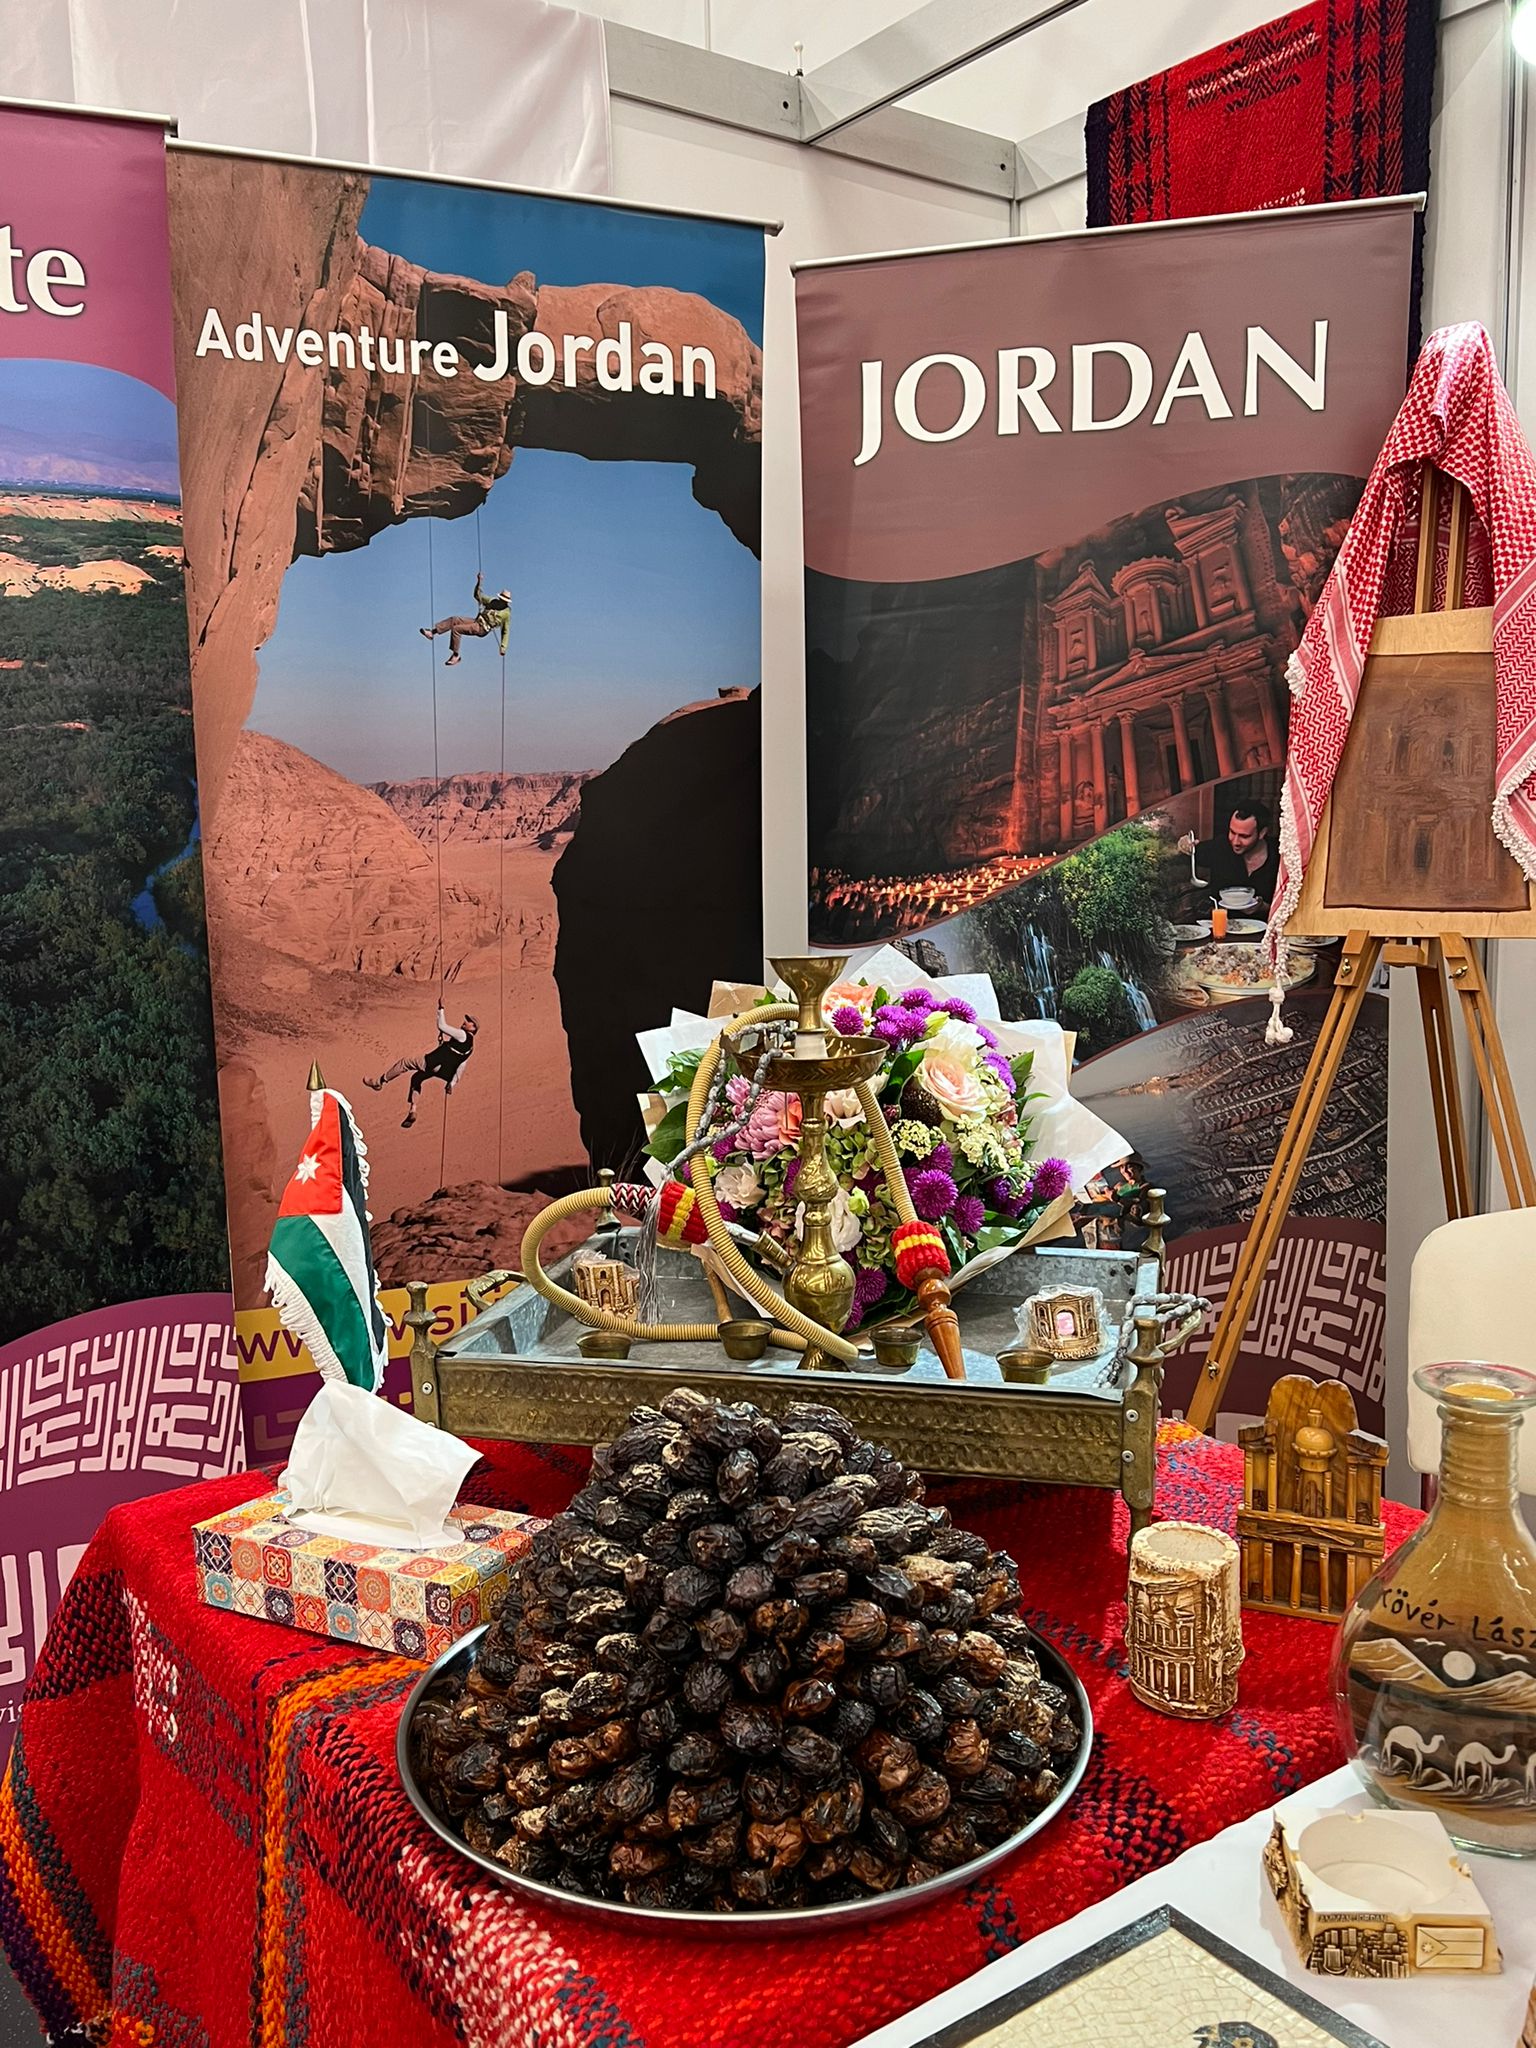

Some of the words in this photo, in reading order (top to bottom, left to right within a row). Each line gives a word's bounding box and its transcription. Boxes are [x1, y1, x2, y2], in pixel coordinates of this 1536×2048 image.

[195, 308, 460, 379] Adventure
[473, 310, 718, 399] Jordan
[853, 320, 1329, 466] JORDAN
